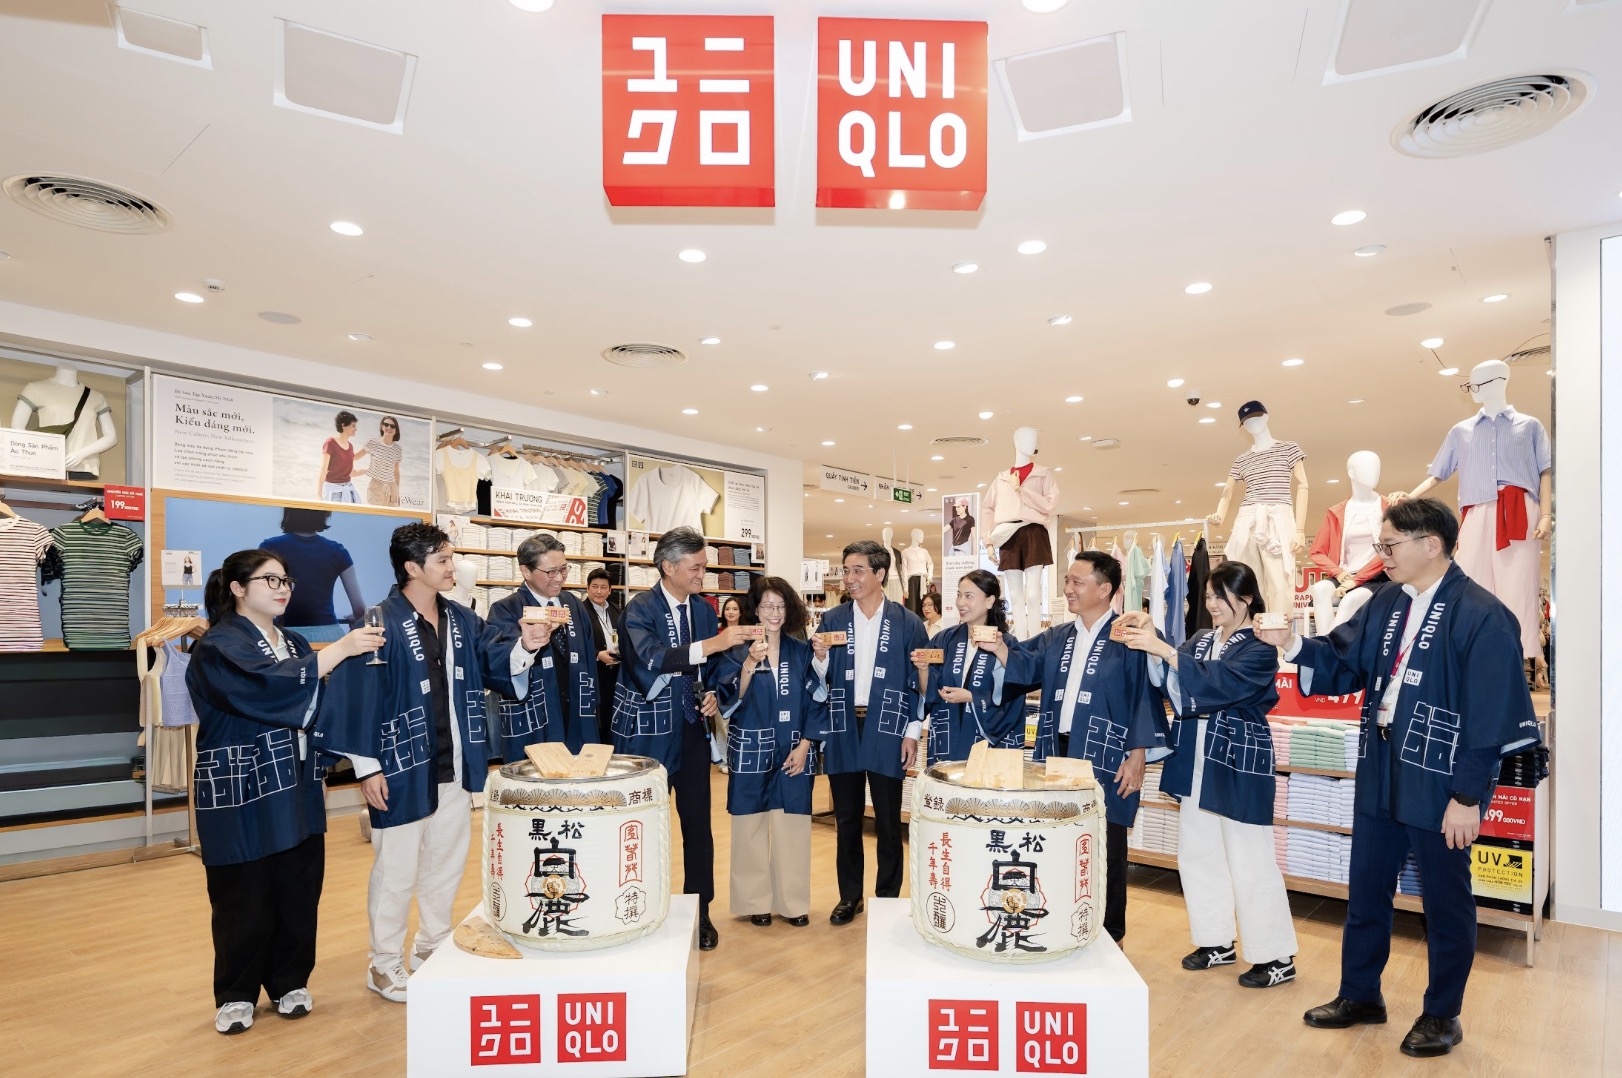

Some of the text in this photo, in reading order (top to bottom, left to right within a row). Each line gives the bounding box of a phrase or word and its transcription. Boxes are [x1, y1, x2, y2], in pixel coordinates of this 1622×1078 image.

[627, 36, 750, 92] ユニ
[838, 39, 955, 99] UNI
[622, 110, 750, 165] クロ
[838, 110, 966, 178] QLO
[175, 403, 199, 415] Màu
[202, 408, 218, 417] sắc
[175, 415, 201, 426] Kiểu
[204, 419, 230, 433] dáng
[495, 491, 513, 500] KHAI
[402, 620, 424, 661] UNIQLO
[665, 613, 678, 648] UNIQLO
[880, 619, 891, 653] UNIQLO
[1382, 611, 1401, 656] UNIQLO
[1418, 602, 1446, 650] UNIQLO
[953, 642, 966, 674] UNIQLO
[1060, 636, 1075, 673] UNIQLO
[1086, 640, 1106, 675] UNIQLO
[780, 662, 789, 695] UNIQLO
[972, 653, 988, 687] UNIQLO
[529, 818, 585, 841] 黒松
[985, 829, 1047, 853] 黒松
[940, 832, 952, 892] 長生自得
[1478, 851, 1501, 866] UV
[1478, 867, 1523, 877] PROTECTION
[479, 1003, 531, 1027] ユニ
[565, 1001, 614, 1026] UNI
[938, 1008, 989, 1032] ユニ
[1024, 1010, 1074, 1036] UNI
[478, 1032, 532, 1057] クロ
[565, 1030, 619, 1058] QLO
[936, 1038, 989, 1062] クロ
[1024, 1039, 1079, 1068] QLO
